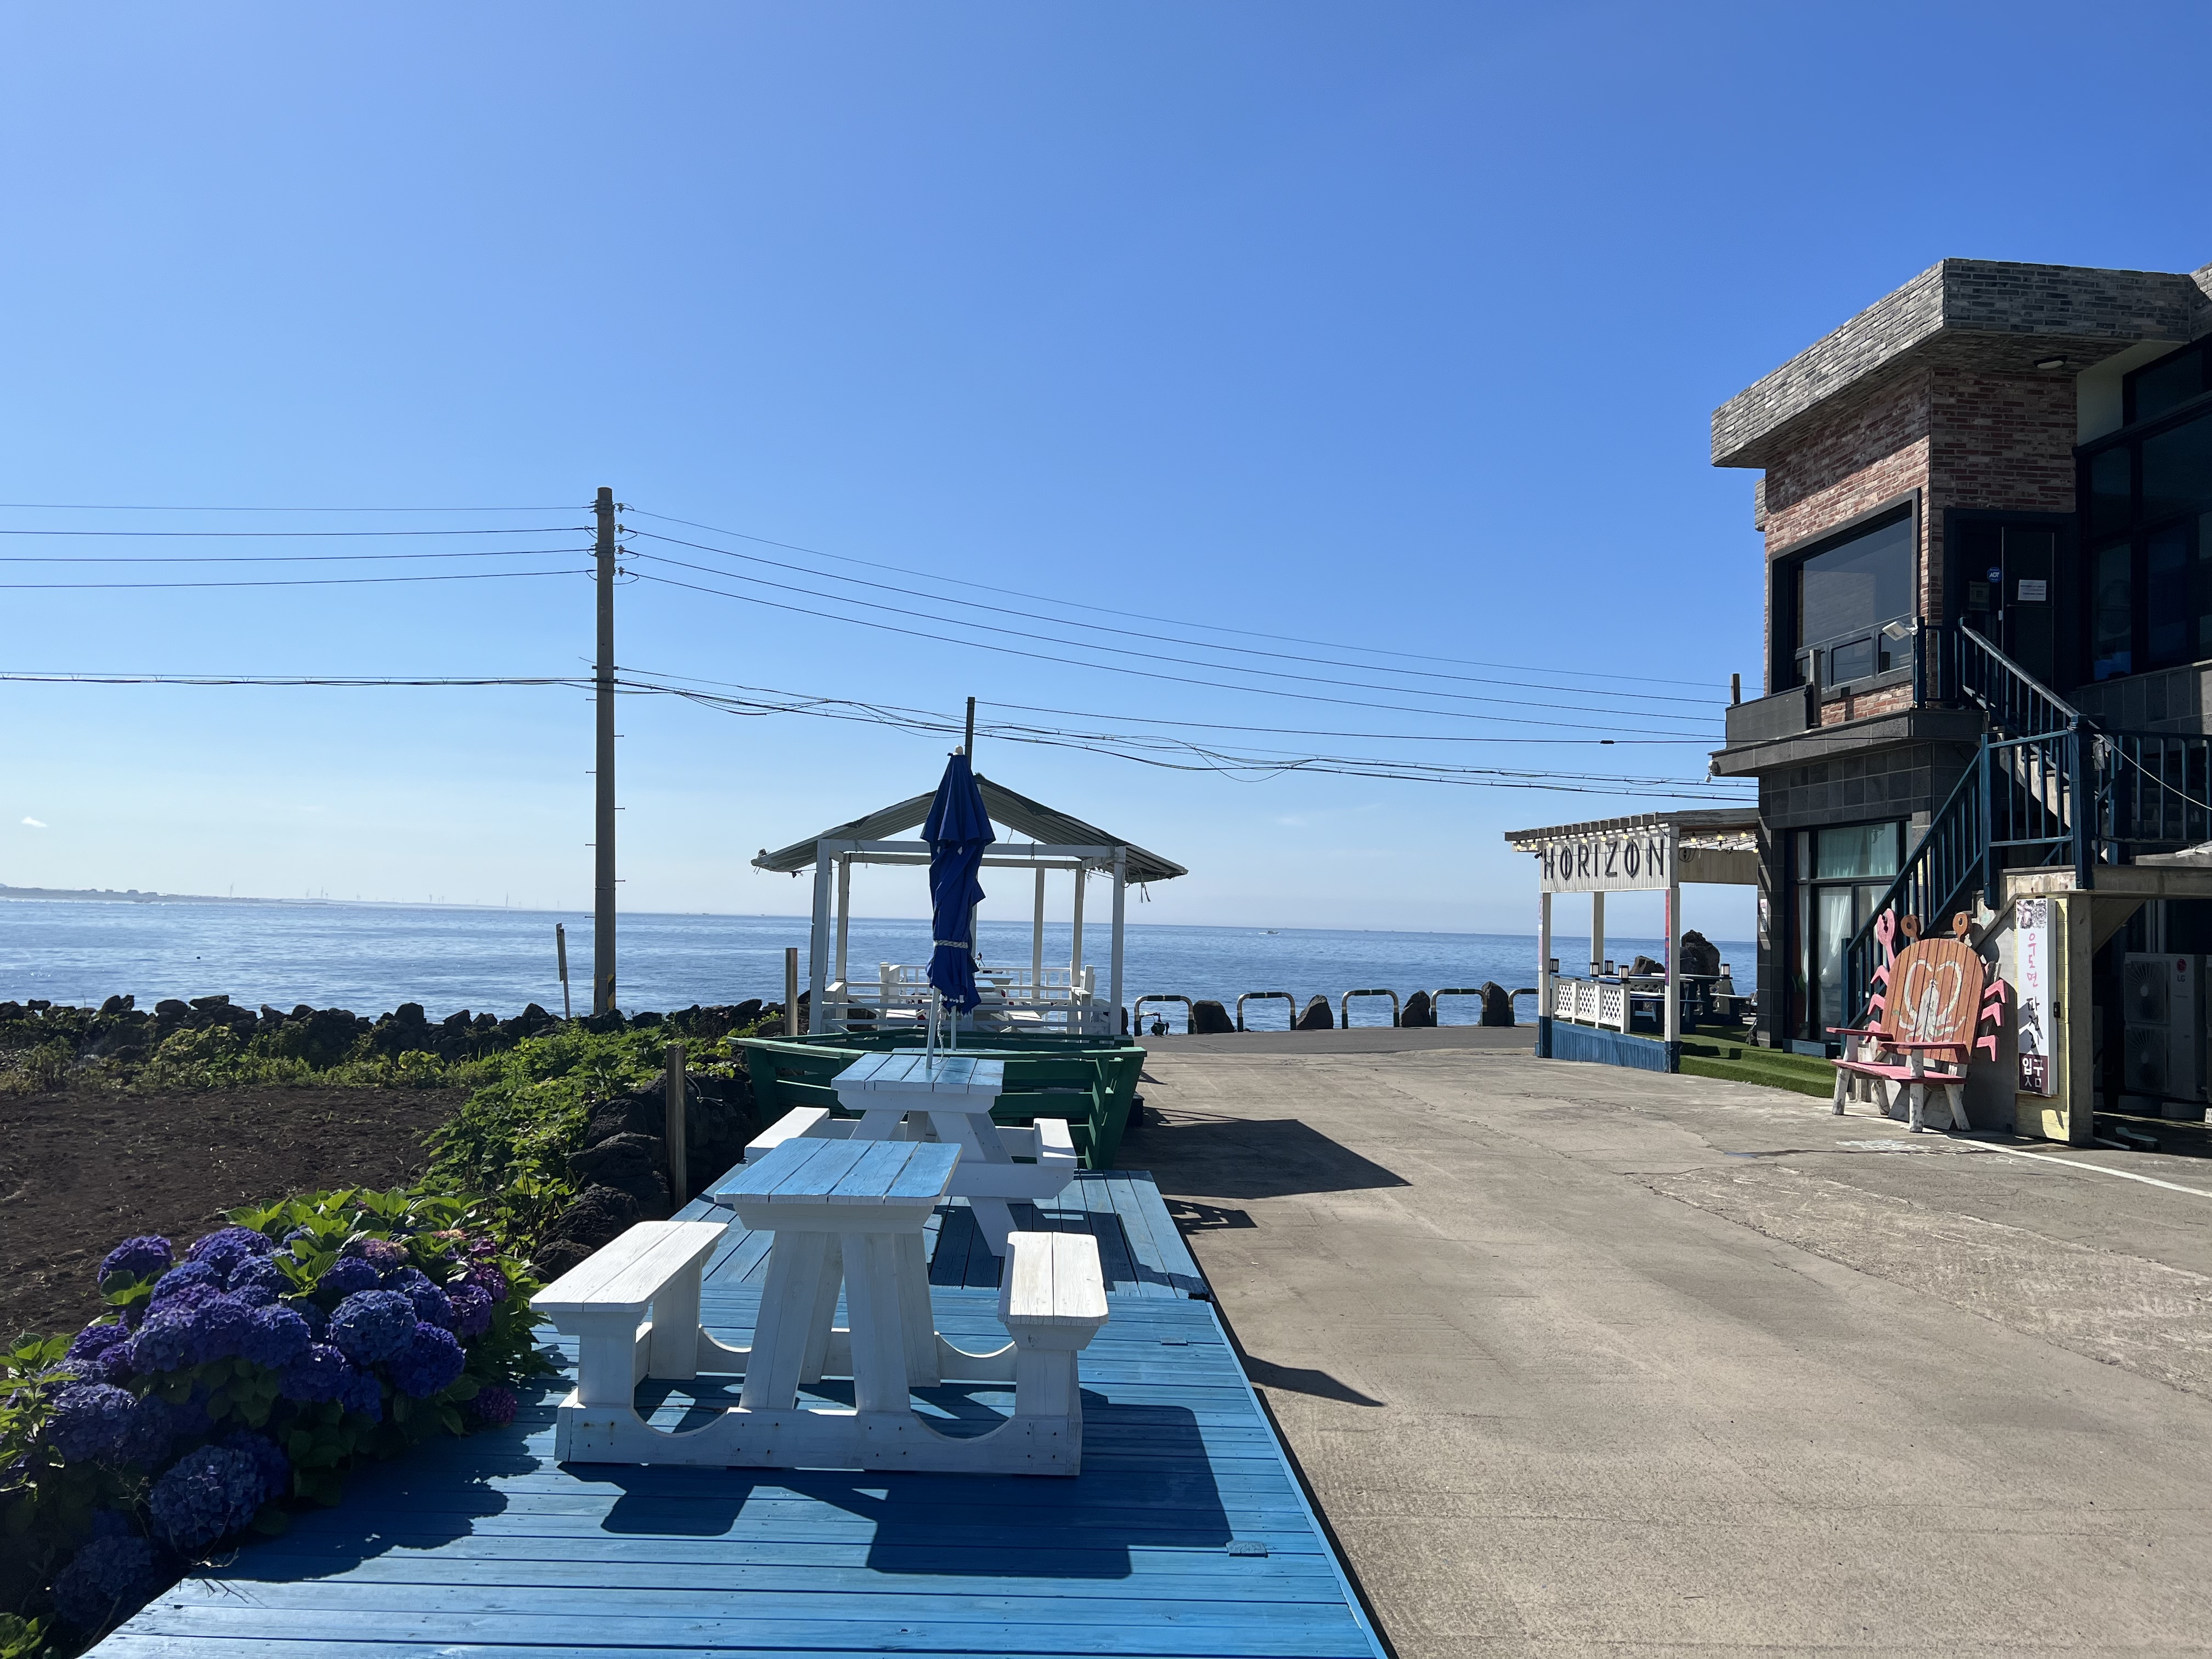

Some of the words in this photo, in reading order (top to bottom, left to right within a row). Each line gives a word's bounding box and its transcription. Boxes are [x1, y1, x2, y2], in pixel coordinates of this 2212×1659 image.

[1543, 839, 1664, 881] HORIZON
[2026, 933, 2039, 988] 우도면
[2022, 1057, 2044, 1076] 입구
